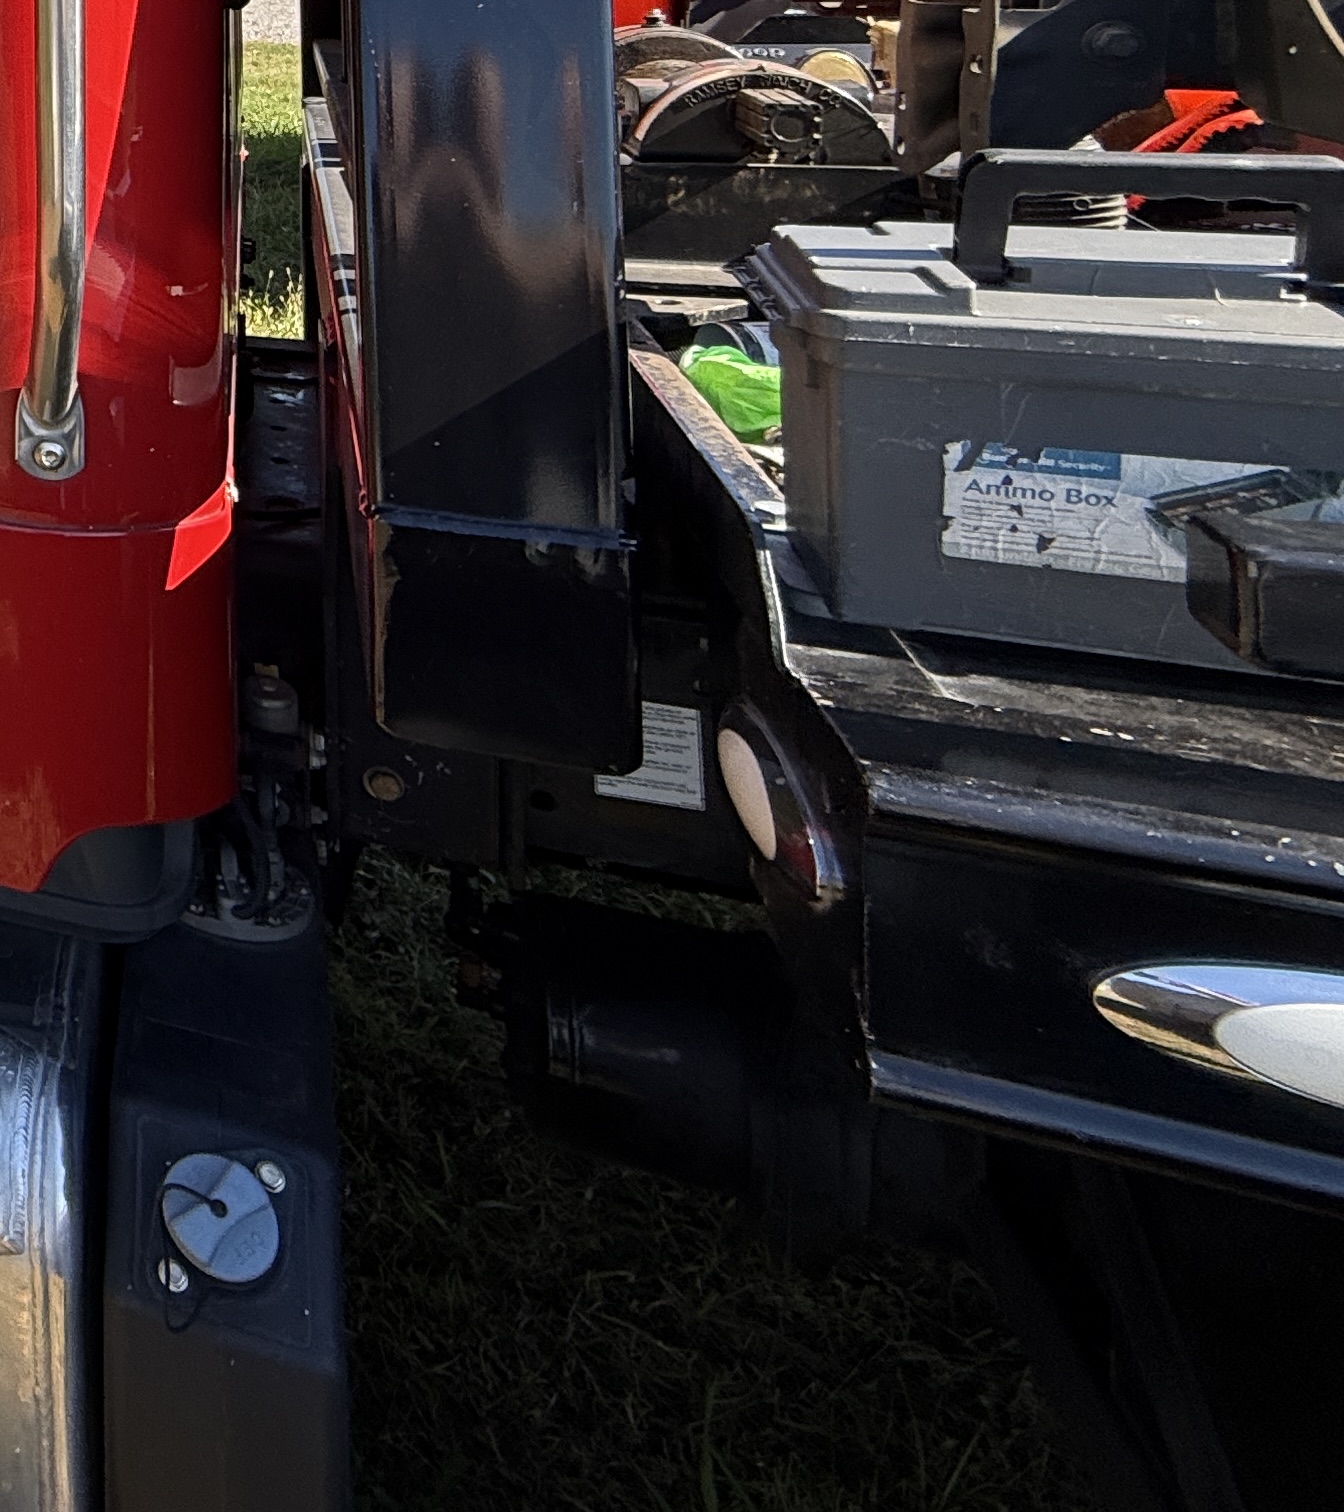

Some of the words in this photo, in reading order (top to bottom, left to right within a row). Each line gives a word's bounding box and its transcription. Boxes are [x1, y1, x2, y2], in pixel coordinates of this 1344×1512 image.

[684, 76, 747, 107] RAMSEY
[964, 478, 1055, 502] Ammo
[1066, 488, 1118, 508] Box
